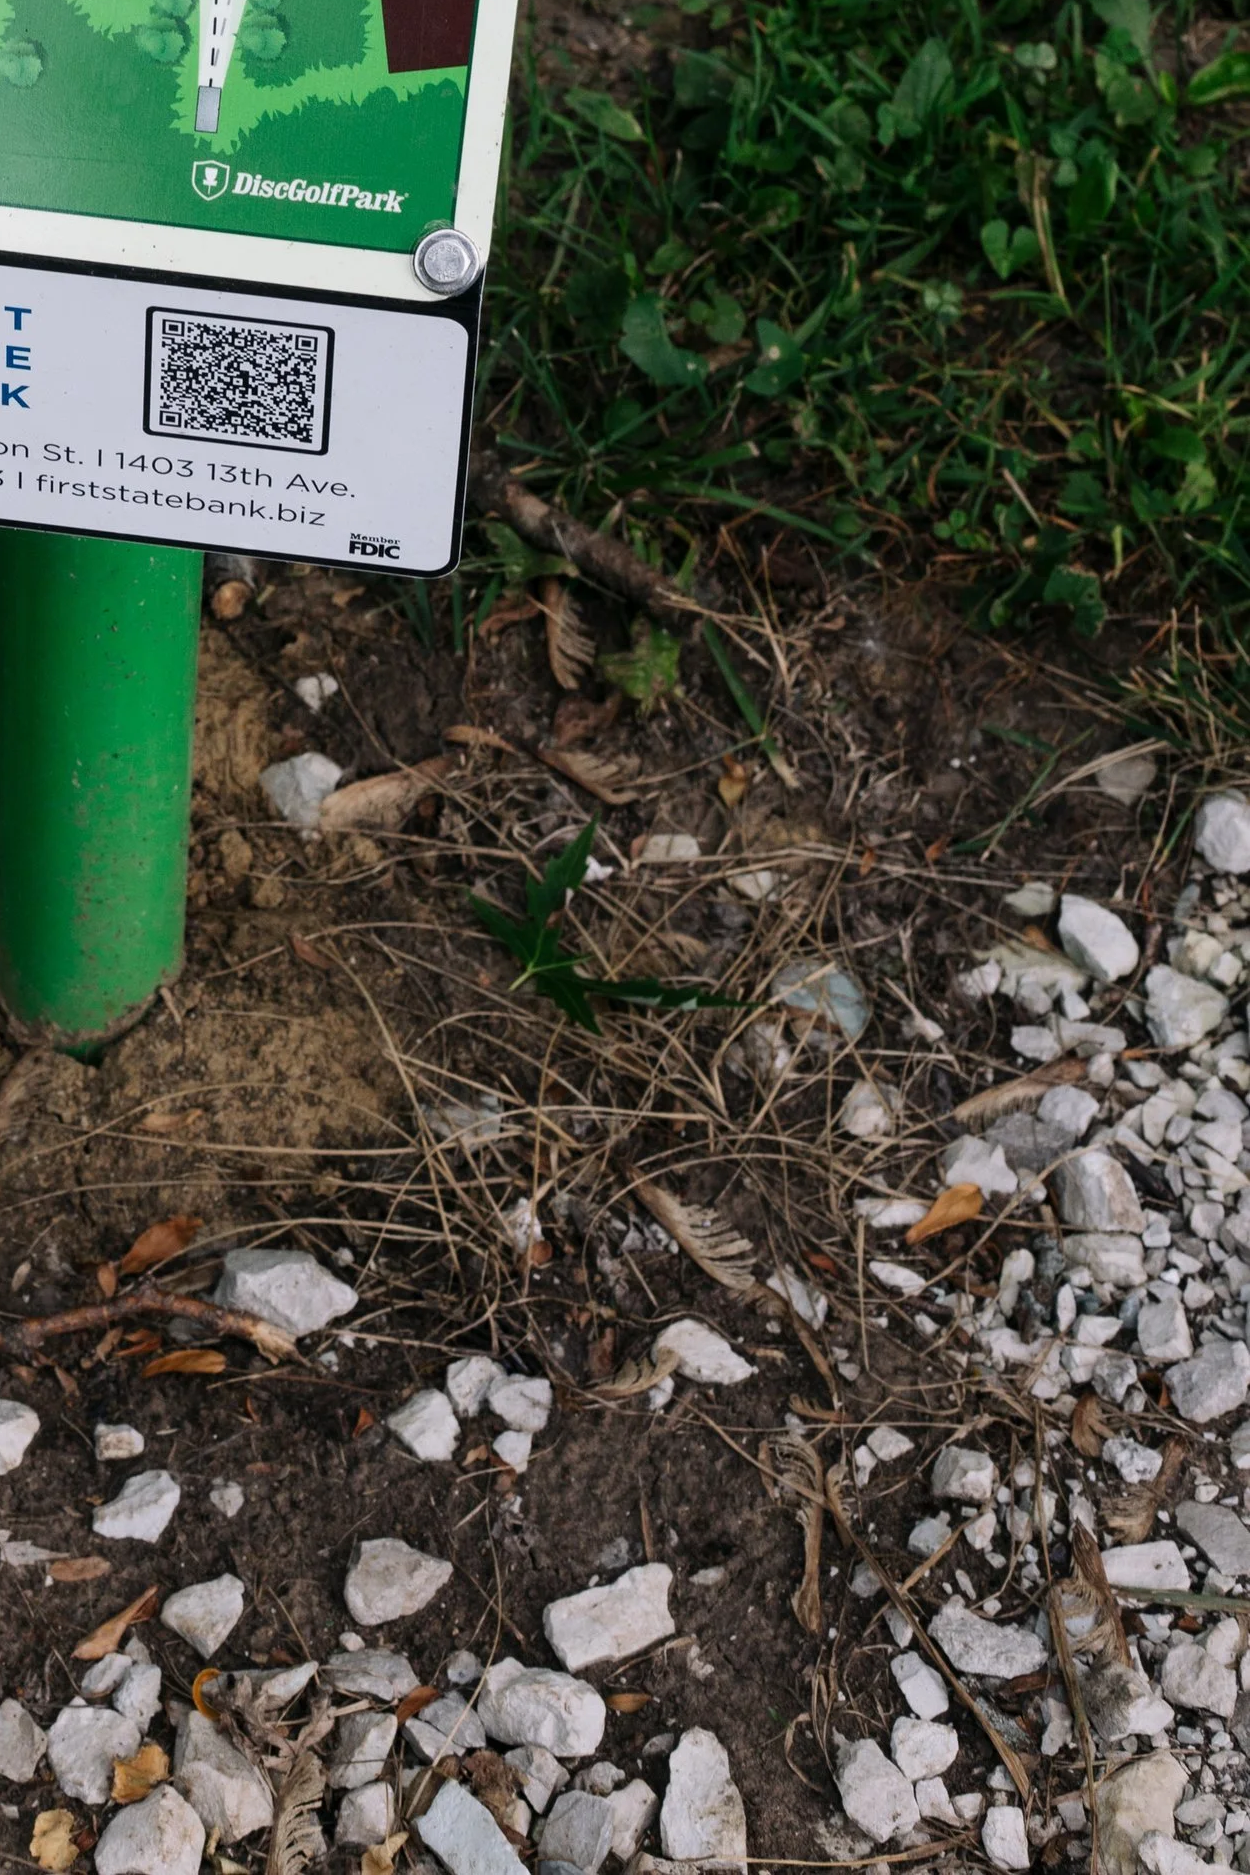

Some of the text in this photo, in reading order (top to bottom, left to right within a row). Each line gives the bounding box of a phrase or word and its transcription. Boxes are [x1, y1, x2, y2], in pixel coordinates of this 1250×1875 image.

[42, 443, 84, 465] St.
[115, 451, 195, 478] 1403
[207, 463, 272, 488] 13th
[285, 473, 356, 498] Ave.
[36, 474, 326, 526] firststatebank.biz
[349, 540, 400, 560] FDIC
[350, 532, 400, 545] Member
